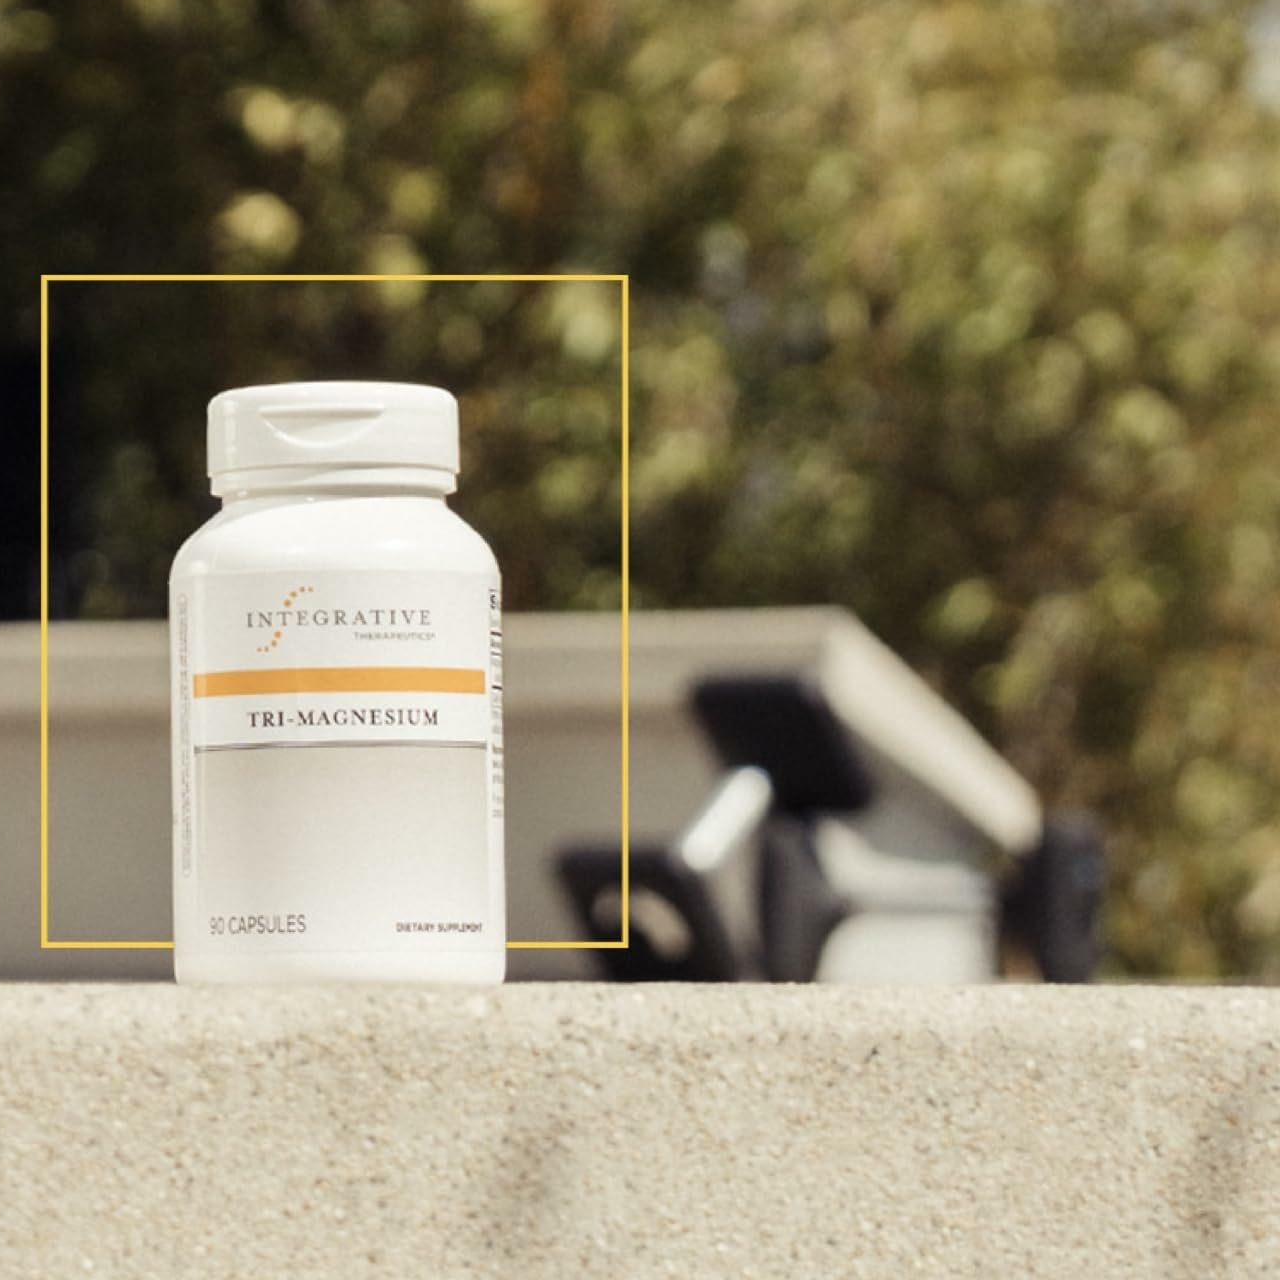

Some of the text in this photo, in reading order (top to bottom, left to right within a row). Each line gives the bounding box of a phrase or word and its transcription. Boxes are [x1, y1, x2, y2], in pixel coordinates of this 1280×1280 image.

[247, 609, 431, 628] INTEGRATIVE
[248, 709, 439, 728] TRI-MAGNESIUM
[209, 914, 306, 935] 90 CAPSULES
